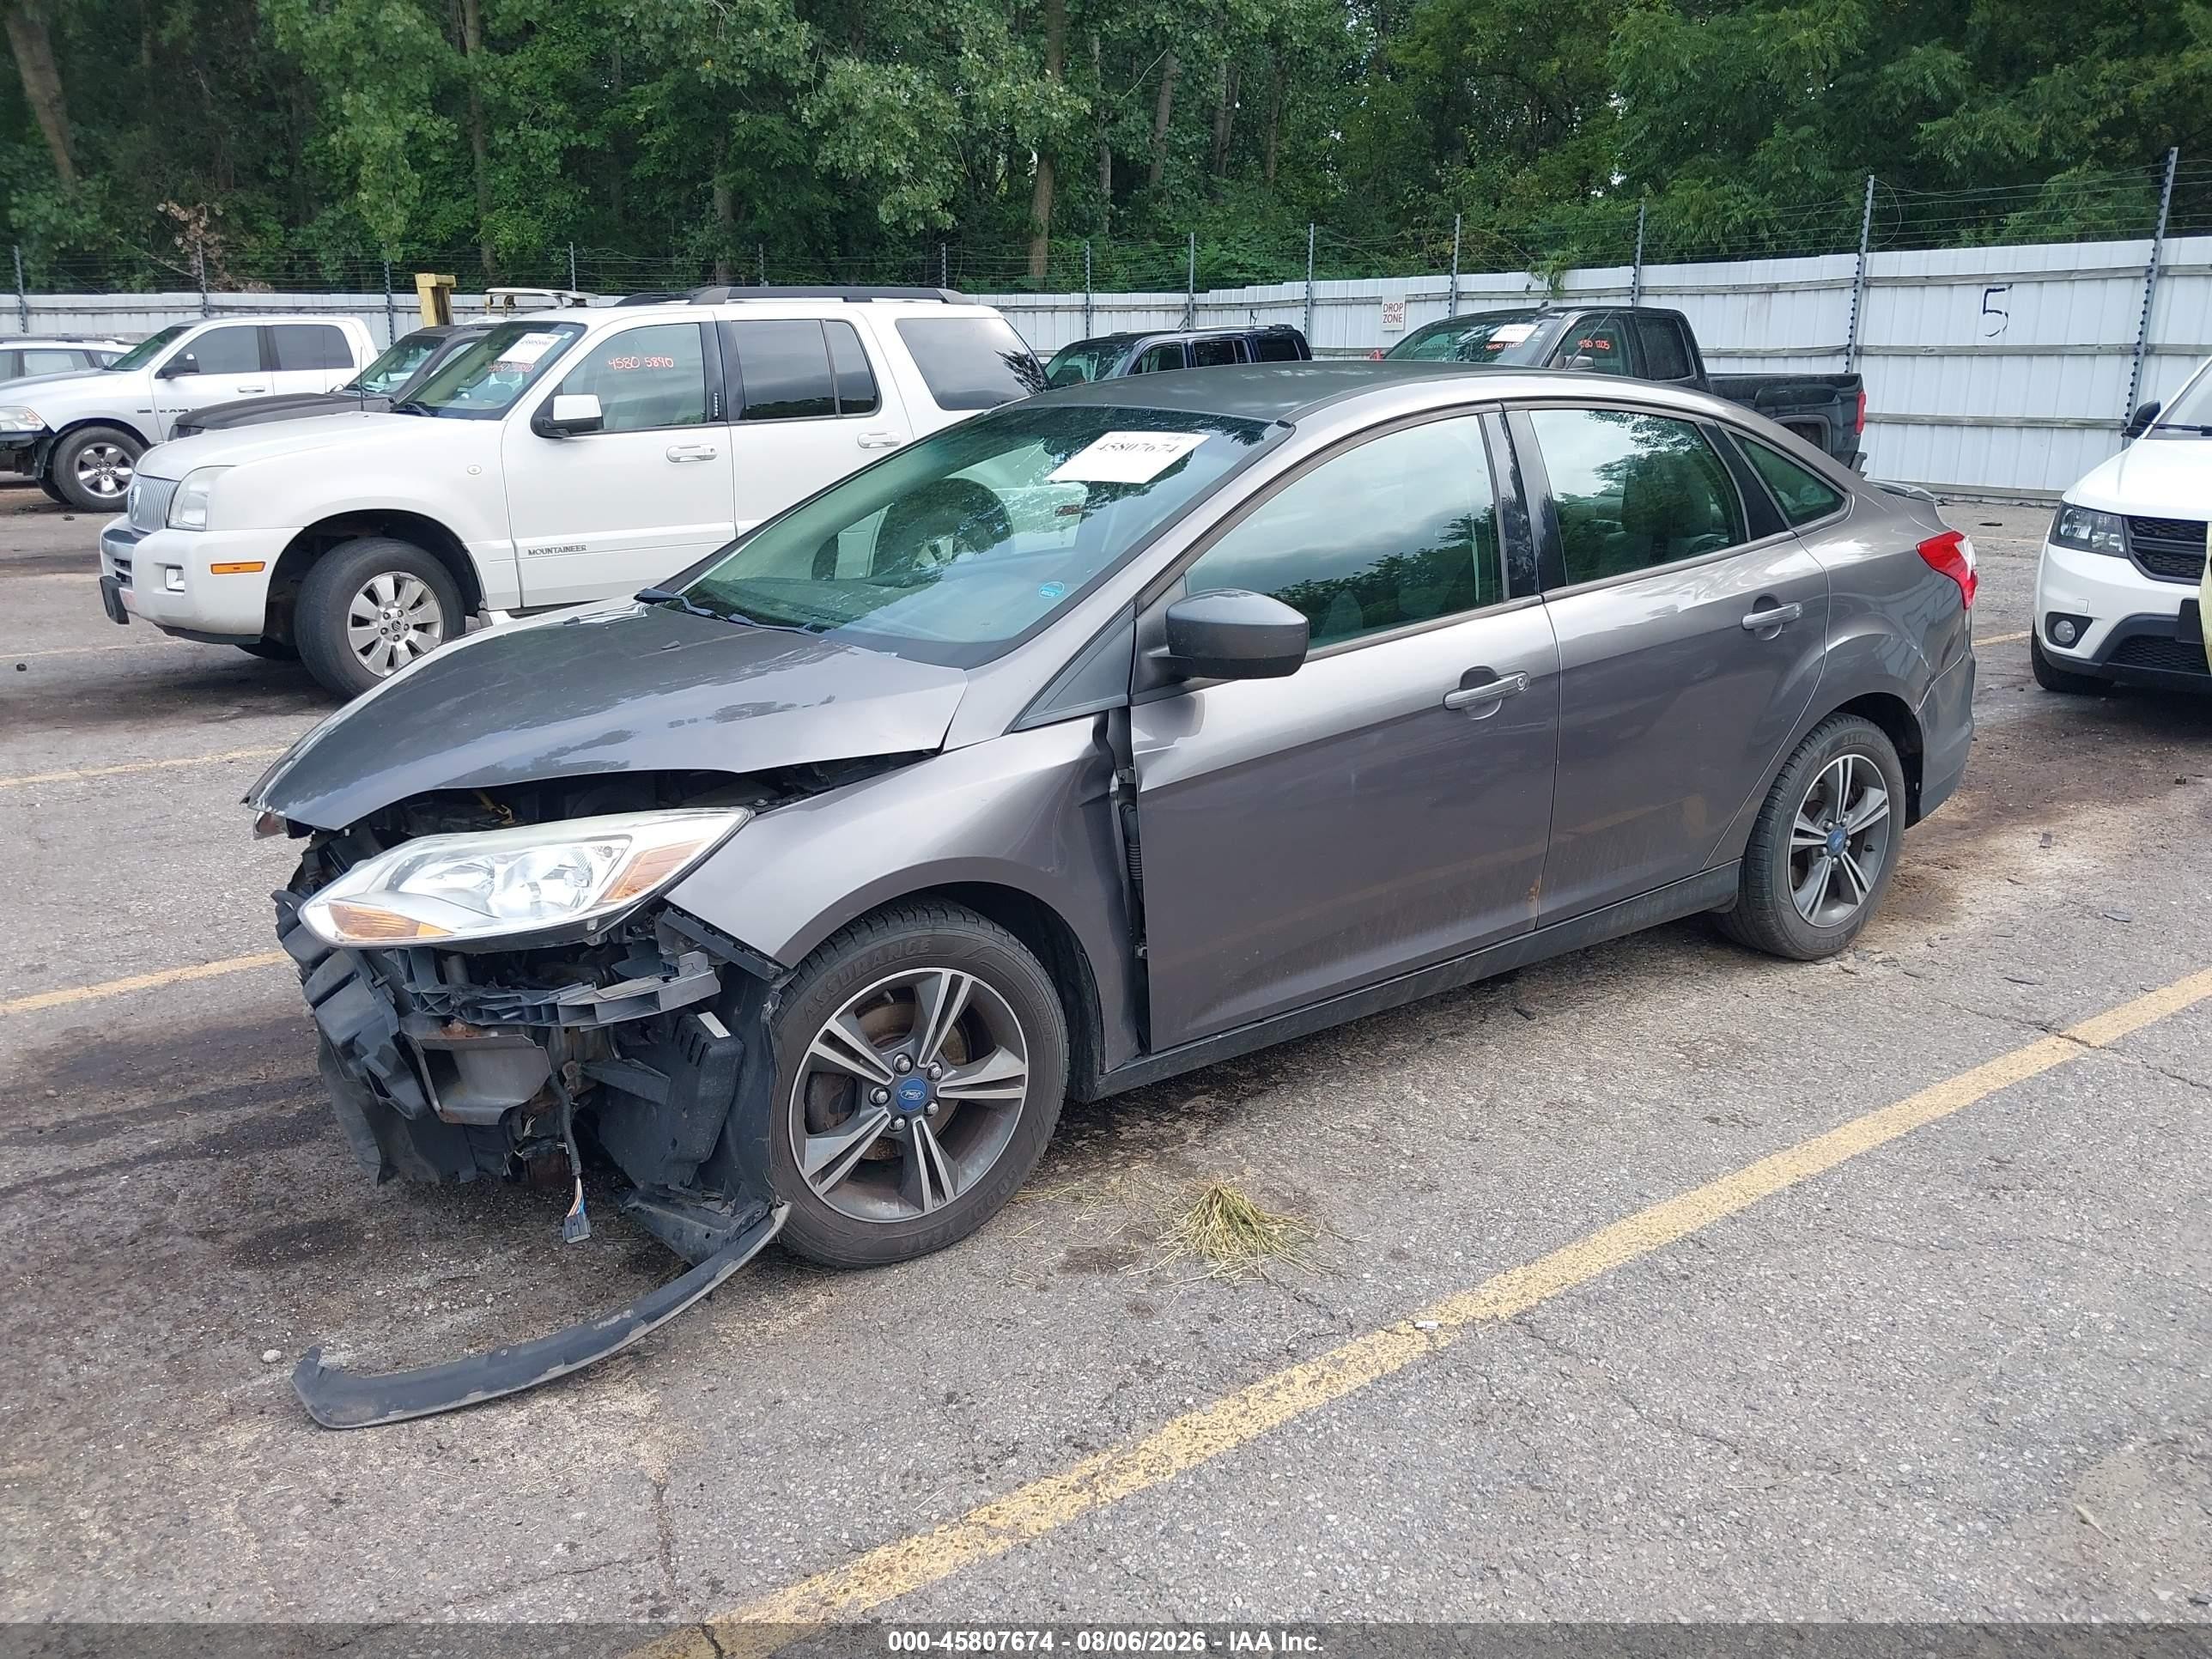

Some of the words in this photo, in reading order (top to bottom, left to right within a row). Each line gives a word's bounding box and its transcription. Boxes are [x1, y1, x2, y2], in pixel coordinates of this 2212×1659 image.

[1383, 303, 1403, 313] DROP
[1983, 284, 2013, 337] 5
[1382, 314, 1402, 323] ZONE
[609, 356, 640, 369] 4580
[528, 544, 586, 556] MOUNTAINEER
